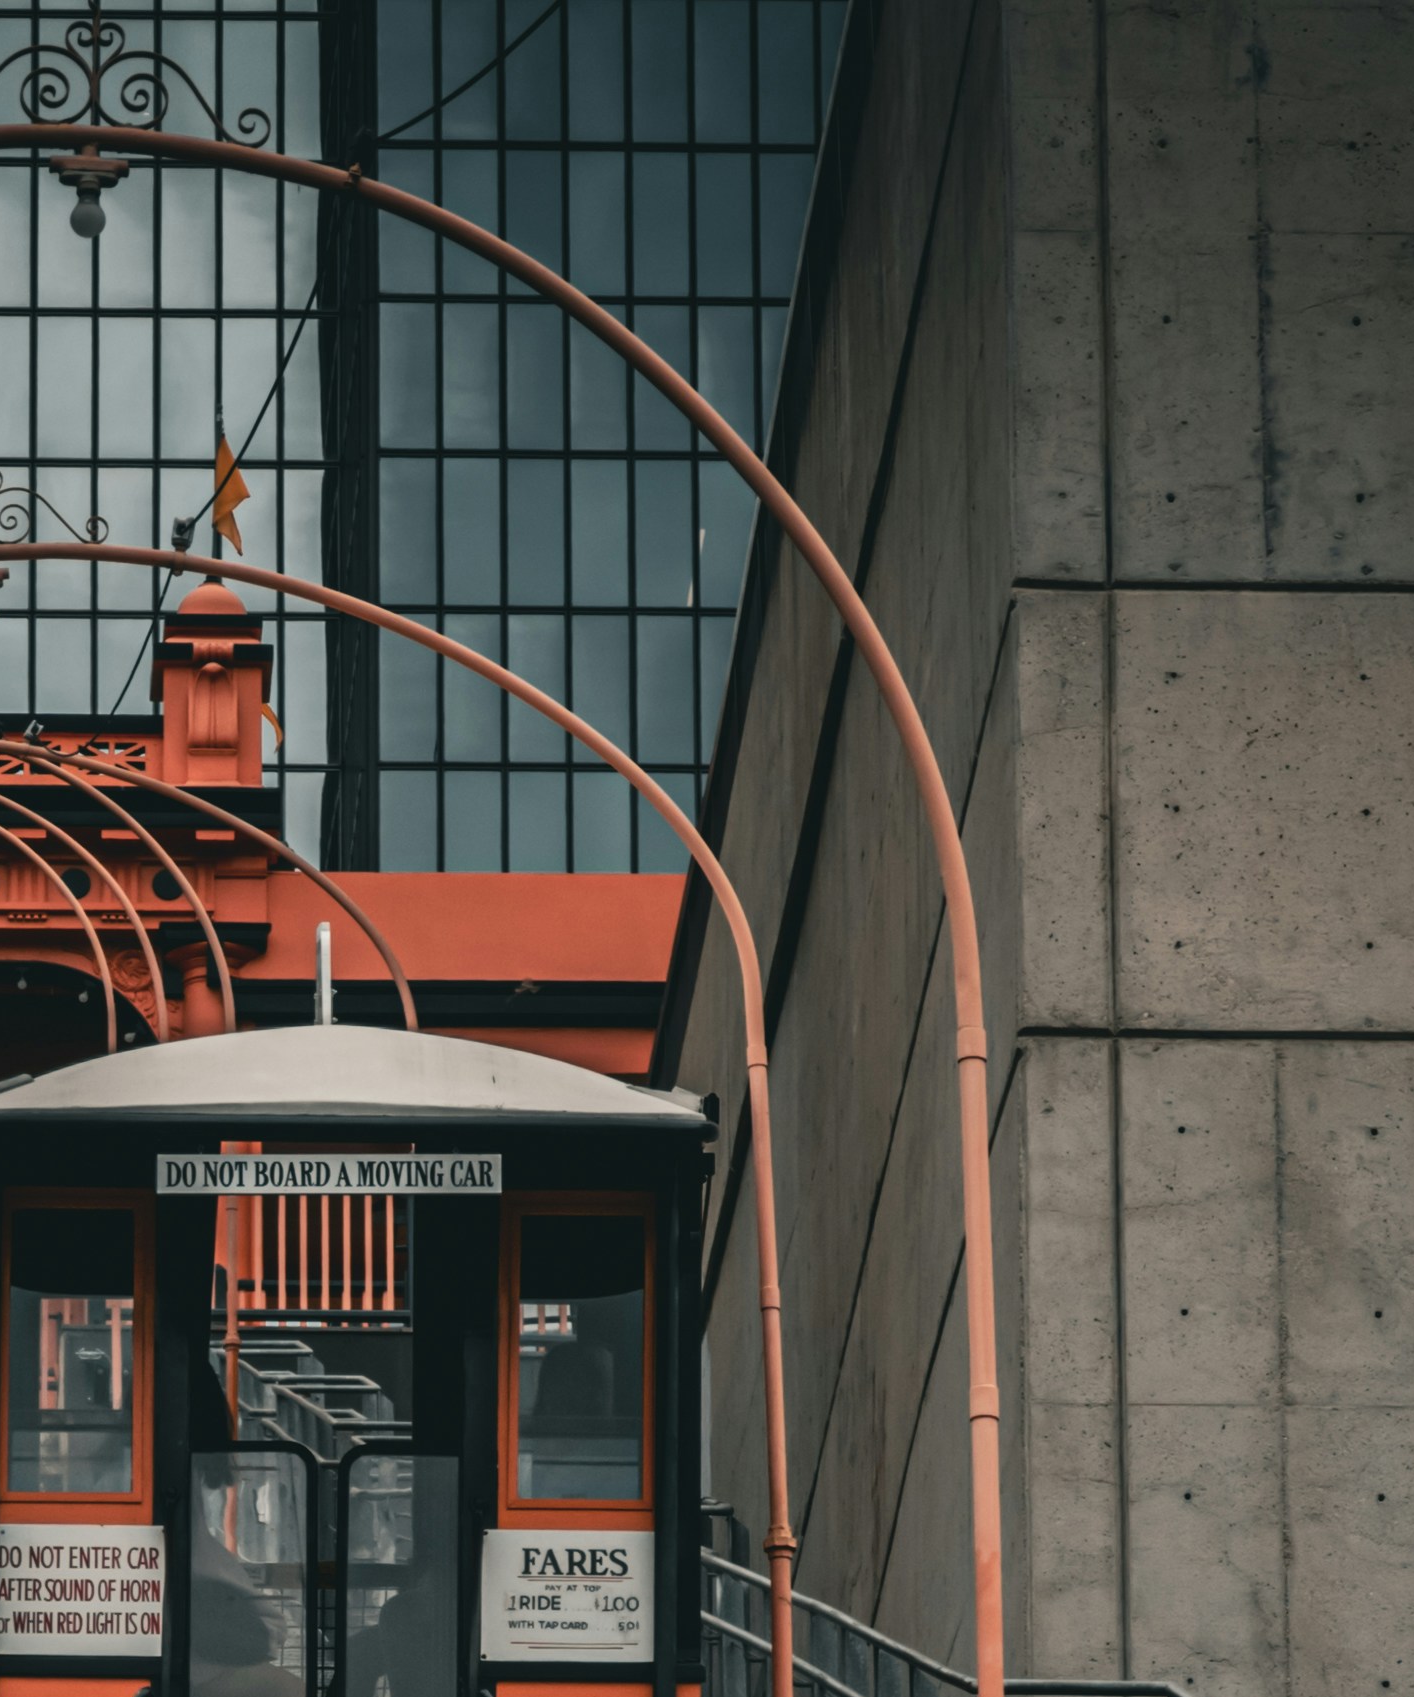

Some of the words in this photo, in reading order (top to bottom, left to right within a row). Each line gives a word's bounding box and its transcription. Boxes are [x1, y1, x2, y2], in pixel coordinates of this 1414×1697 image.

[165, 1161, 197, 1188] DO
[203, 1161, 248, 1188] NOT
[254, 1161, 331, 1188] BOARD
[335, 1161, 352, 1188] A
[356, 1161, 444, 1188] MOVING
[450, 1161, 494, 1188] CAR
[29, 1546, 64, 1569] NOT
[69, 1546, 122, 1569] ENTER
[127, 1547, 160, 1570] CAR
[521, 1547, 629, 1577] FARES
[44, 1578, 95, 1602] SOUND
[98, 1579, 117, 1602] OF
[120, 1580, 161, 1602] HORN
[566, 1584, 577, 1592] AT
[583, 1584, 602, 1592] TOP
[507, 1595, 516, 1611] 1
[519, 1595, 562, 1611] RIDE
[12, 1611, 53, 1634] WHEN
[57, 1611, 83, 1634] RED
[86, 1612, 122, 1635] LIGHT
[125, 1612, 138, 1635] IS
[140, 1612, 161, 1635] ON
[508, 1620, 535, 1629] WITH
[538, 1620, 559, 1629] TAP
[560, 1621, 588, 1630] CARD
